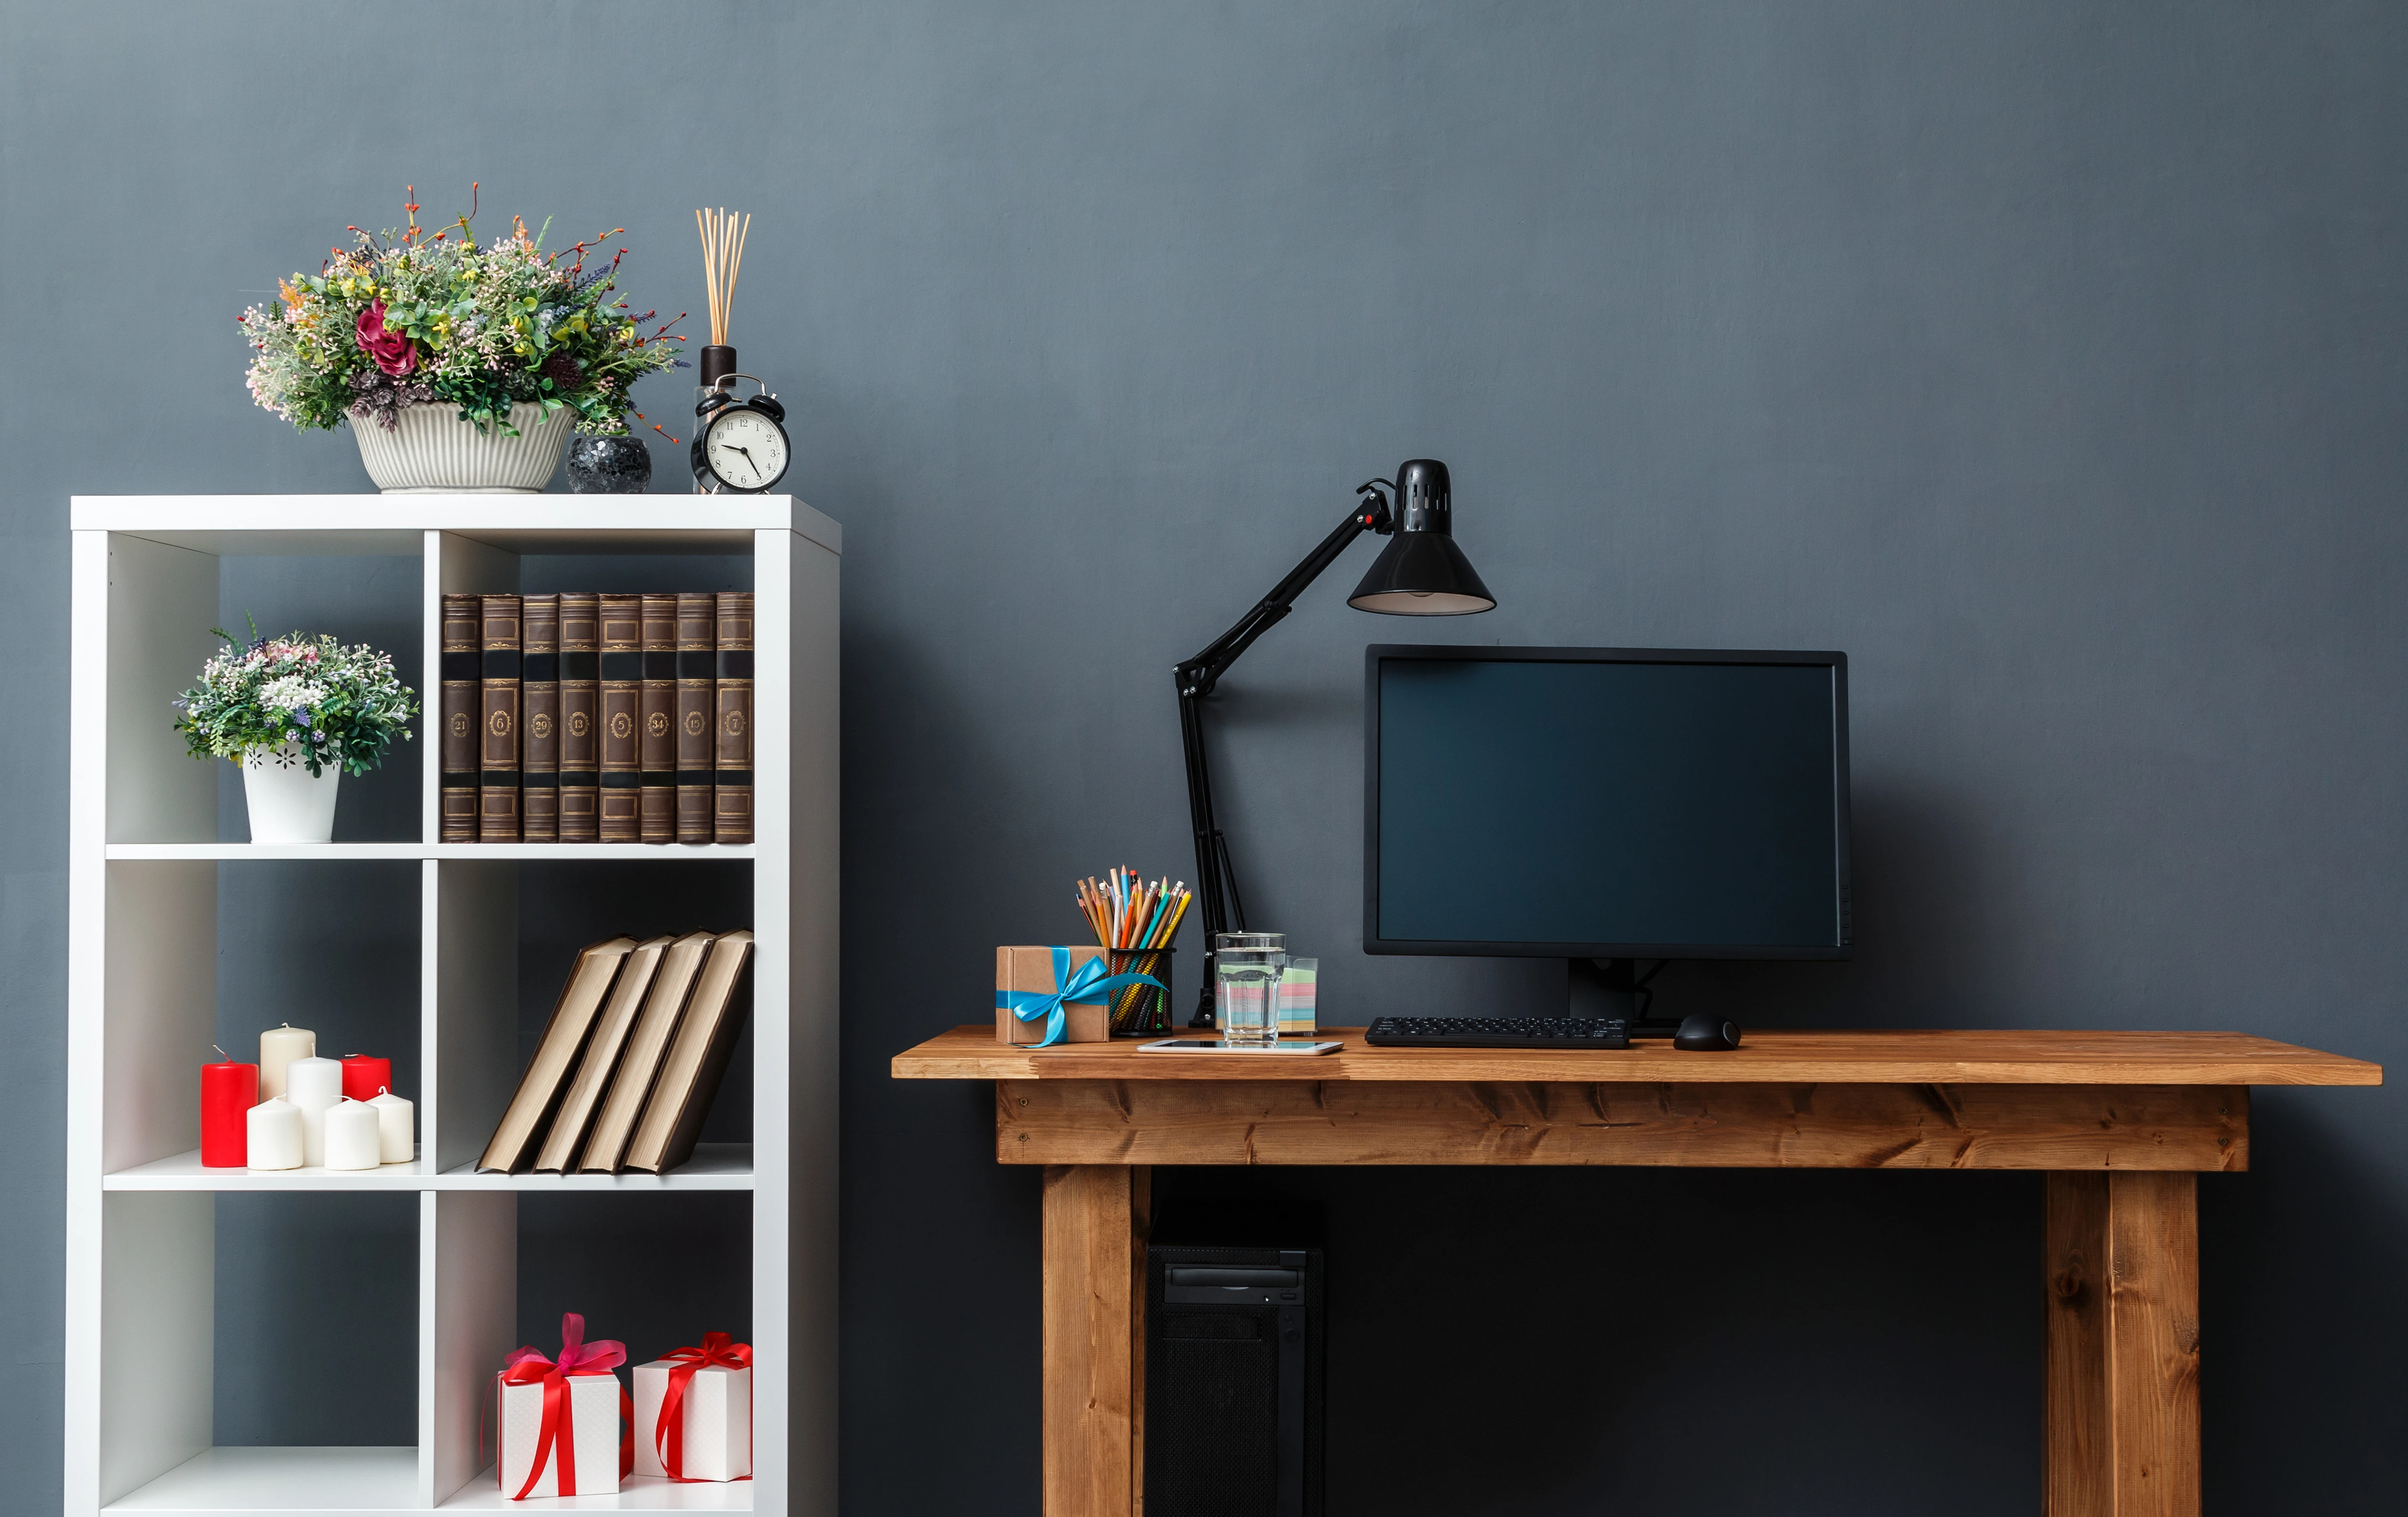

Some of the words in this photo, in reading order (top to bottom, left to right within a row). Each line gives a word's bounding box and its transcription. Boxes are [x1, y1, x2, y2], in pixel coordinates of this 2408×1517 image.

[740, 419, 748, 427] 12
[766, 434, 772, 442] 2
[711, 445, 716, 454] 9
[771, 449, 776, 458] 3
[716, 460, 721, 468] 8
[727, 471, 732, 480] 7
[741, 476, 746, 484] 6
[757, 472, 761, 481] 5
[455, 721, 465, 730] 21
[497, 718, 503, 729] 6
[536, 721, 547, 730] 29
[574, 719, 583, 729] 13
[618, 720, 624, 730] 5
[652, 719, 664, 729] 34
[690, 719, 699, 728] 15
[732, 719, 738, 728] 7
